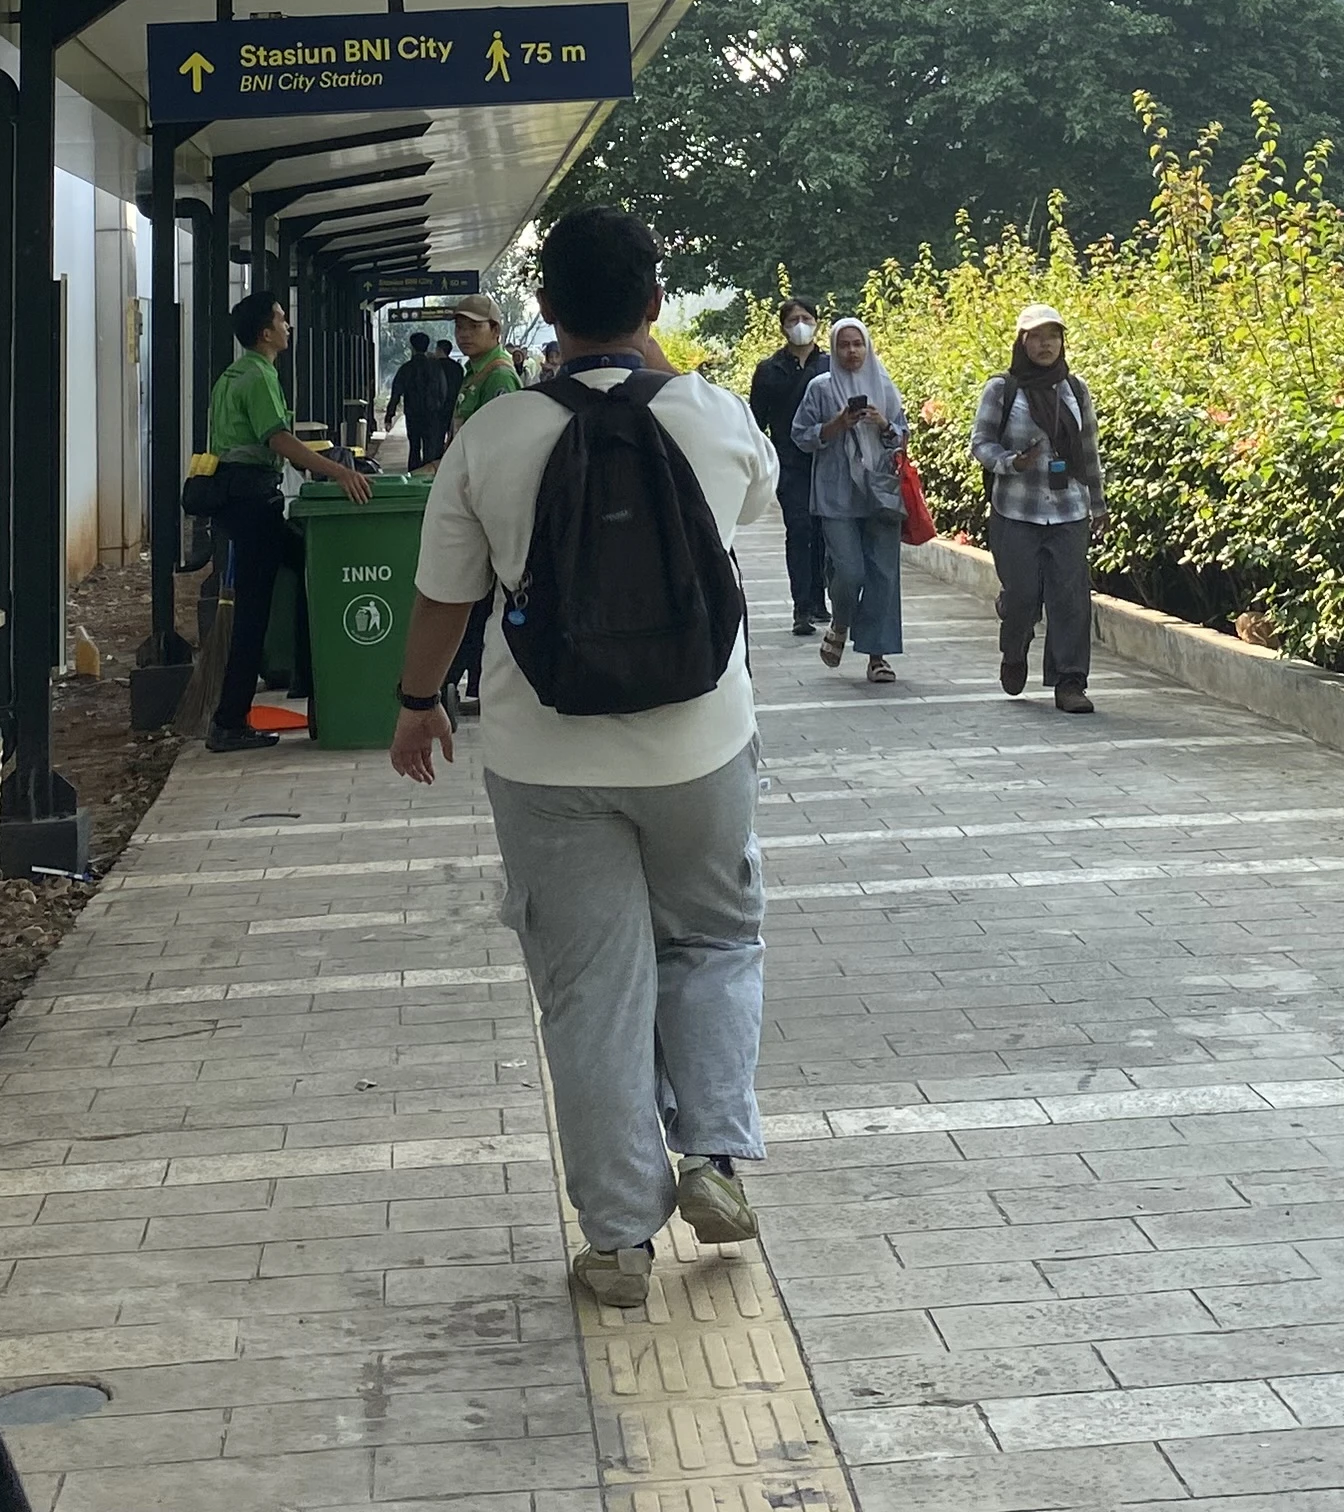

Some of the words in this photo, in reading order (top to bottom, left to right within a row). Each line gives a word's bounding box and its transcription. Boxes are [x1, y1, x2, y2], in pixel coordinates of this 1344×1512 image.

[240, 42, 336, 67] Stasiun
[344, 38, 391, 62] BNI
[397, 36, 453, 63] City
[520, 42, 552, 64] 75
[561, 44, 586, 62] m
[240, 74, 273, 92] BNI
[278, 72, 315, 92] City
[319, 69, 383, 88] Station
[342, 565, 392, 583] INNO
